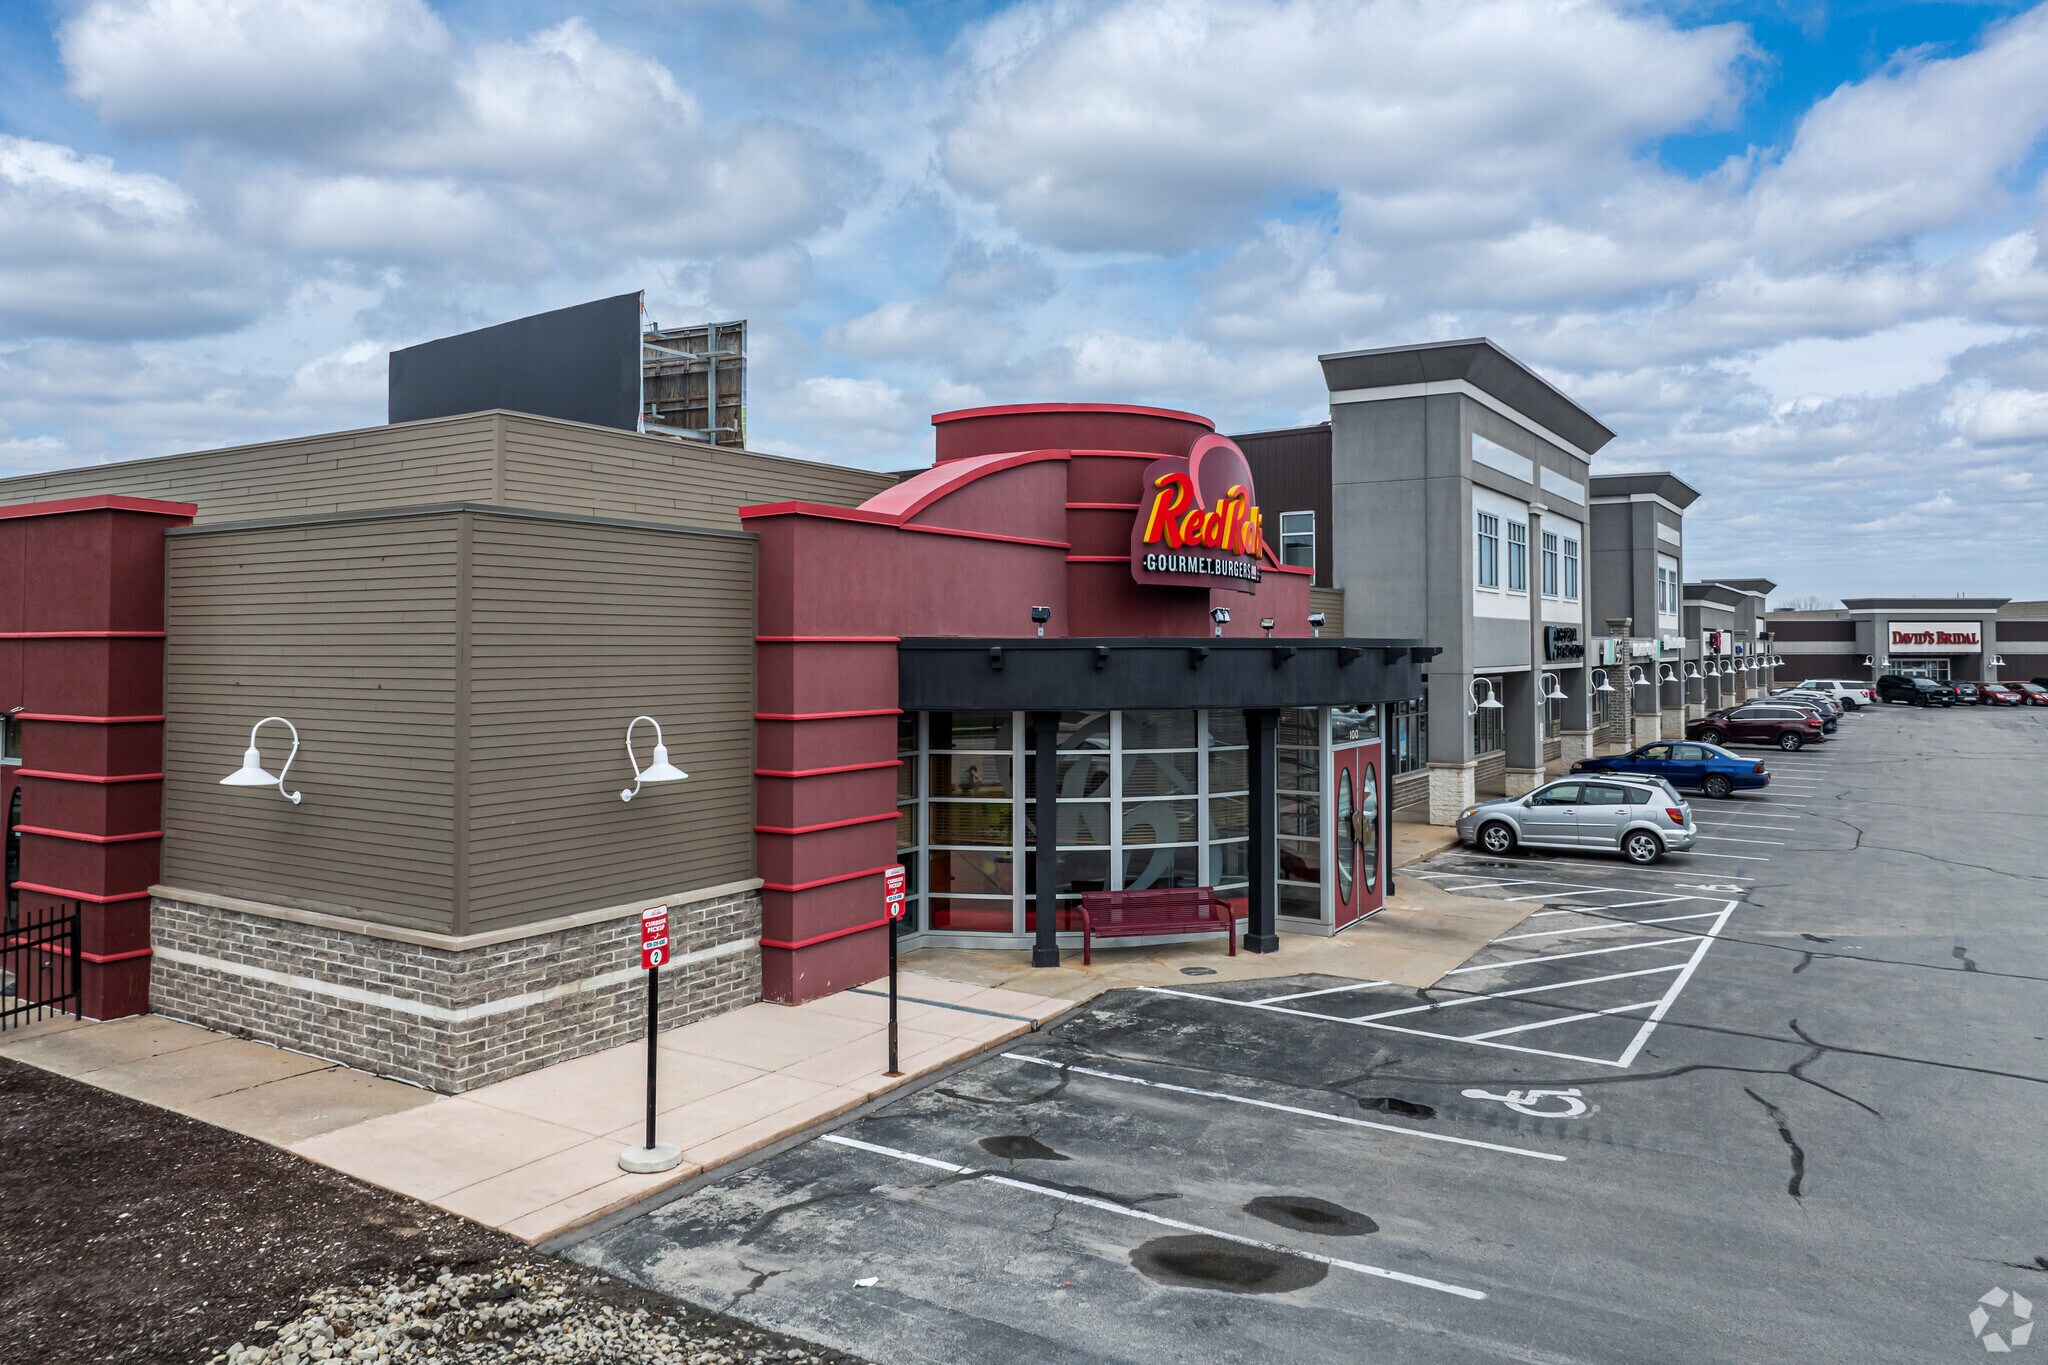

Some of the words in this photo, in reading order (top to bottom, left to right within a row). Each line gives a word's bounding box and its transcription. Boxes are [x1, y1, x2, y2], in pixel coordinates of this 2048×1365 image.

[1143, 472, 1229, 549] Red
[1146, 553, 1210, 574] GOURMET
[1215, 558, 1251, 579] BURGERS
[1936, 630, 1979, 645] BRIDAL
[653, 951, 660, 963] 2
